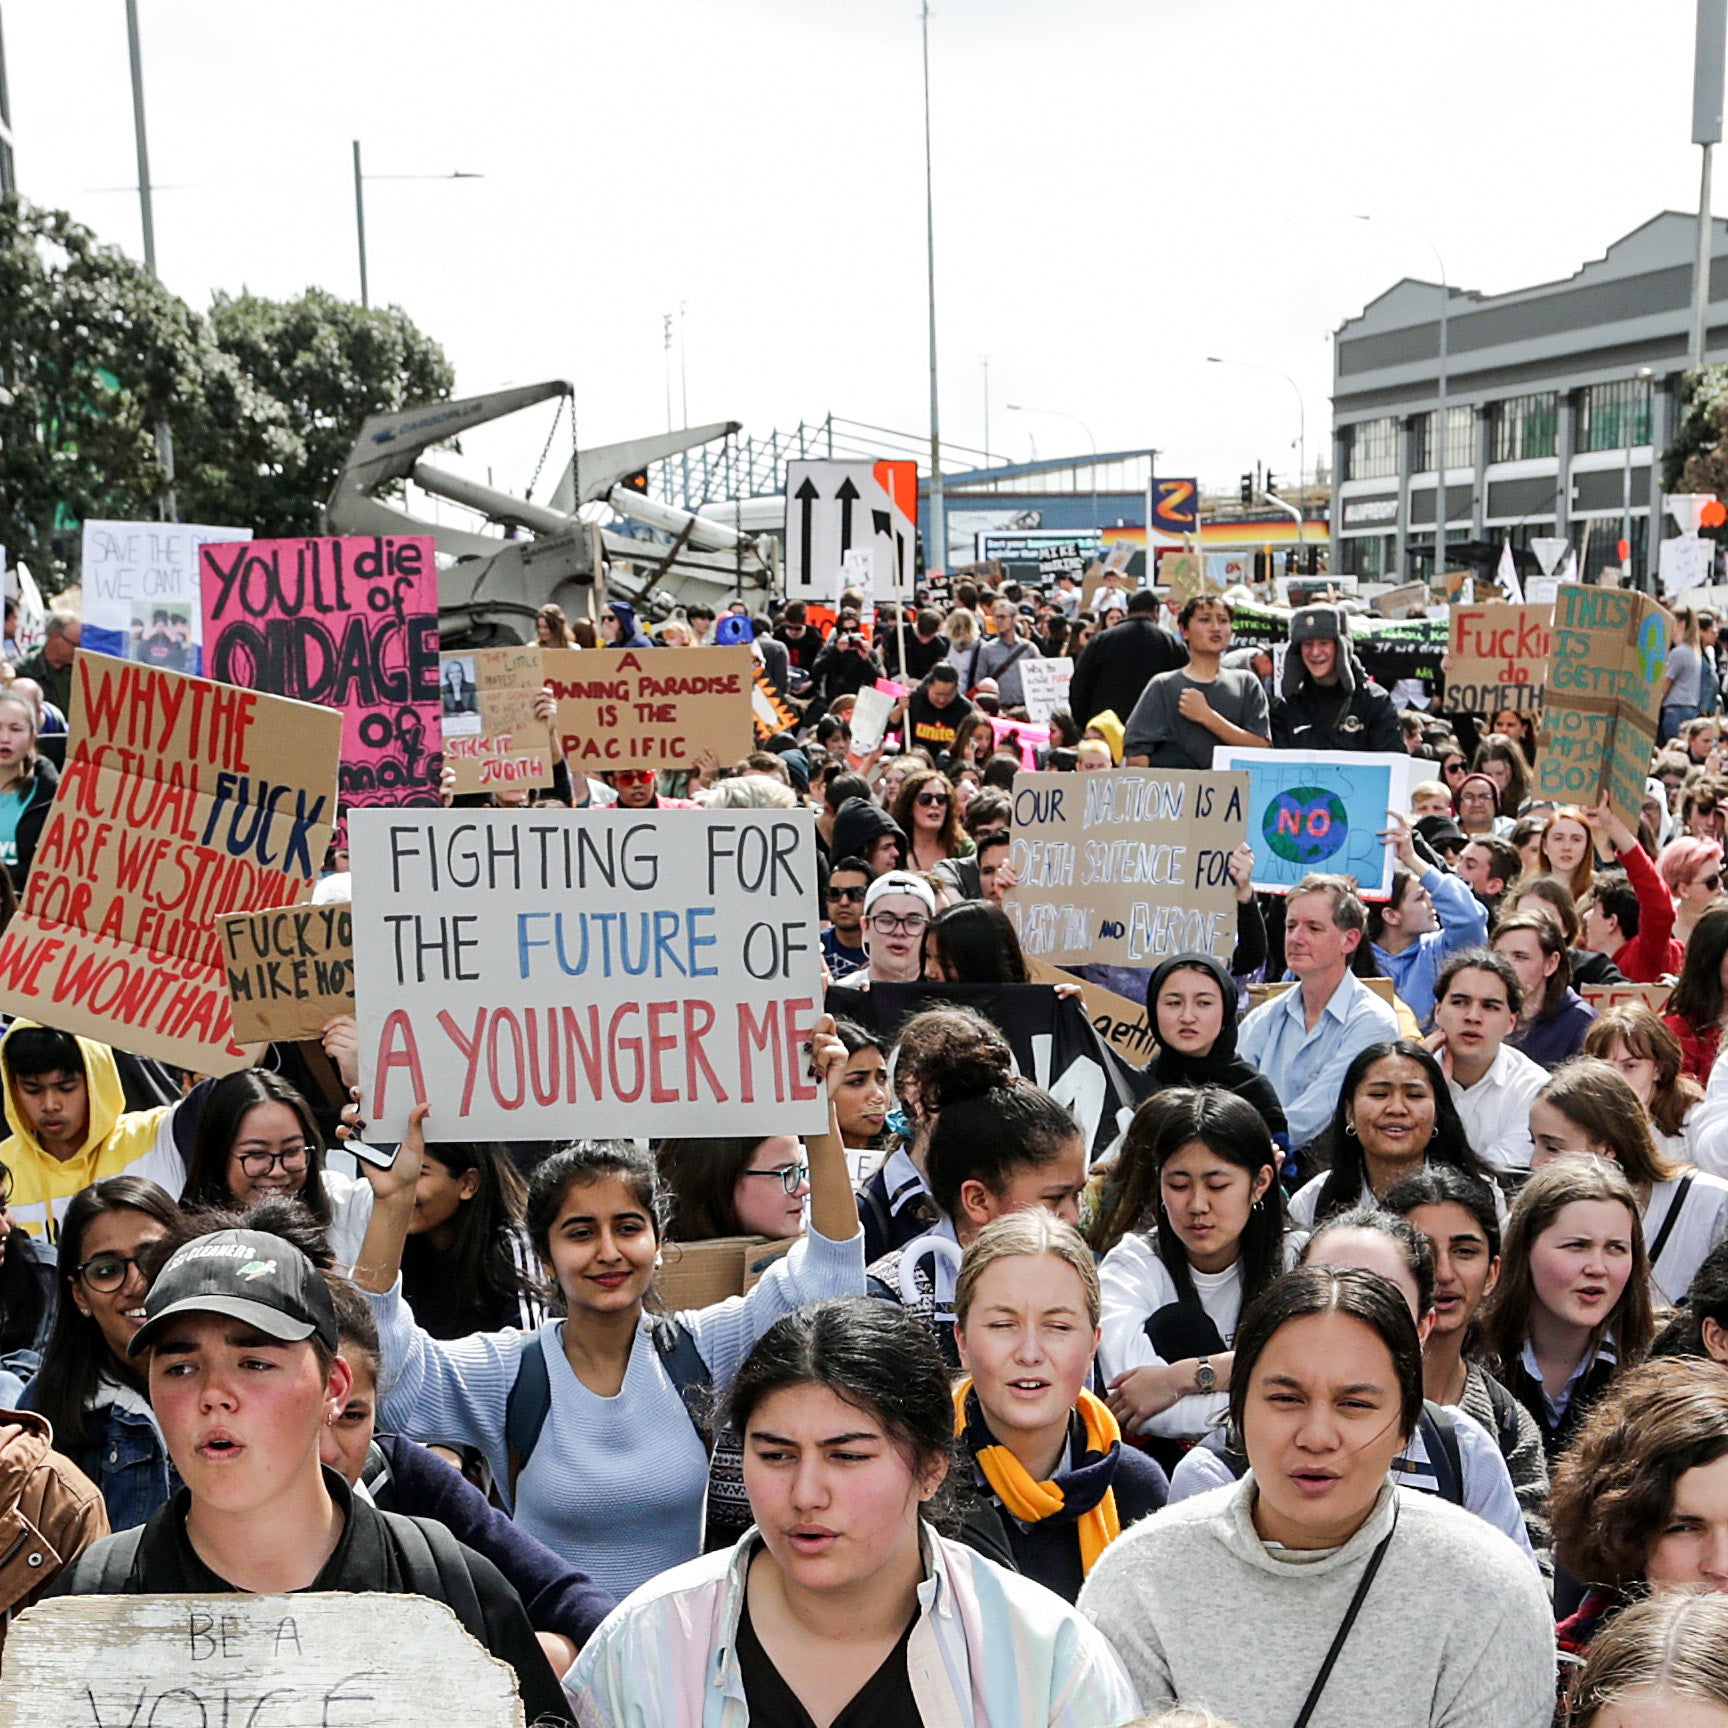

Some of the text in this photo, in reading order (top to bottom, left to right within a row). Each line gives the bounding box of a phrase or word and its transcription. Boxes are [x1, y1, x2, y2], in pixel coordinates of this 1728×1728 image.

[90, 530, 139, 564] SAVE
[146, 533, 181, 566] THE
[354, 539, 423, 580] die
[94, 568, 136, 600] WE
[371, 580, 415, 624] of
[1559, 585, 1632, 629] THIS
[615, 651, 643, 673] A
[1554, 630, 1592, 659] IS
[638, 673, 742, 698] PARADISE
[1498, 661, 1529, 684] do
[359, 705, 424, 748] of
[597, 702, 678, 728] IS THE
[561, 734, 687, 761] PACIFIC
[478, 755, 545, 785] JUDITH
[56, 738, 200, 842] ACTUAL
[201, 772, 327, 881] FUCK
[1014, 787, 1067, 827] OUR
[1195, 784, 1216, 819] IS
[1223, 786, 1242, 823] A
[1276, 808, 1332, 837] NO
[38, 812, 112, 883] ARE
[389, 822, 806, 896] FIGHTING FOR
[1010, 839, 1238, 890] DEATH SENTENCE FOR
[23, 870, 125, 952] FOR A
[1098, 901, 1230, 961] AND EVERYONE
[225, 912, 312, 961] FUCK
[383, 906, 809, 985] THE FUTURE OF
[53, 944, 178, 1032] WONT
[227, 959, 309, 1002] MIKE
[372, 996, 818, 1120] A YOUNGER ME
[188, 1612, 303, 1662] BE A
